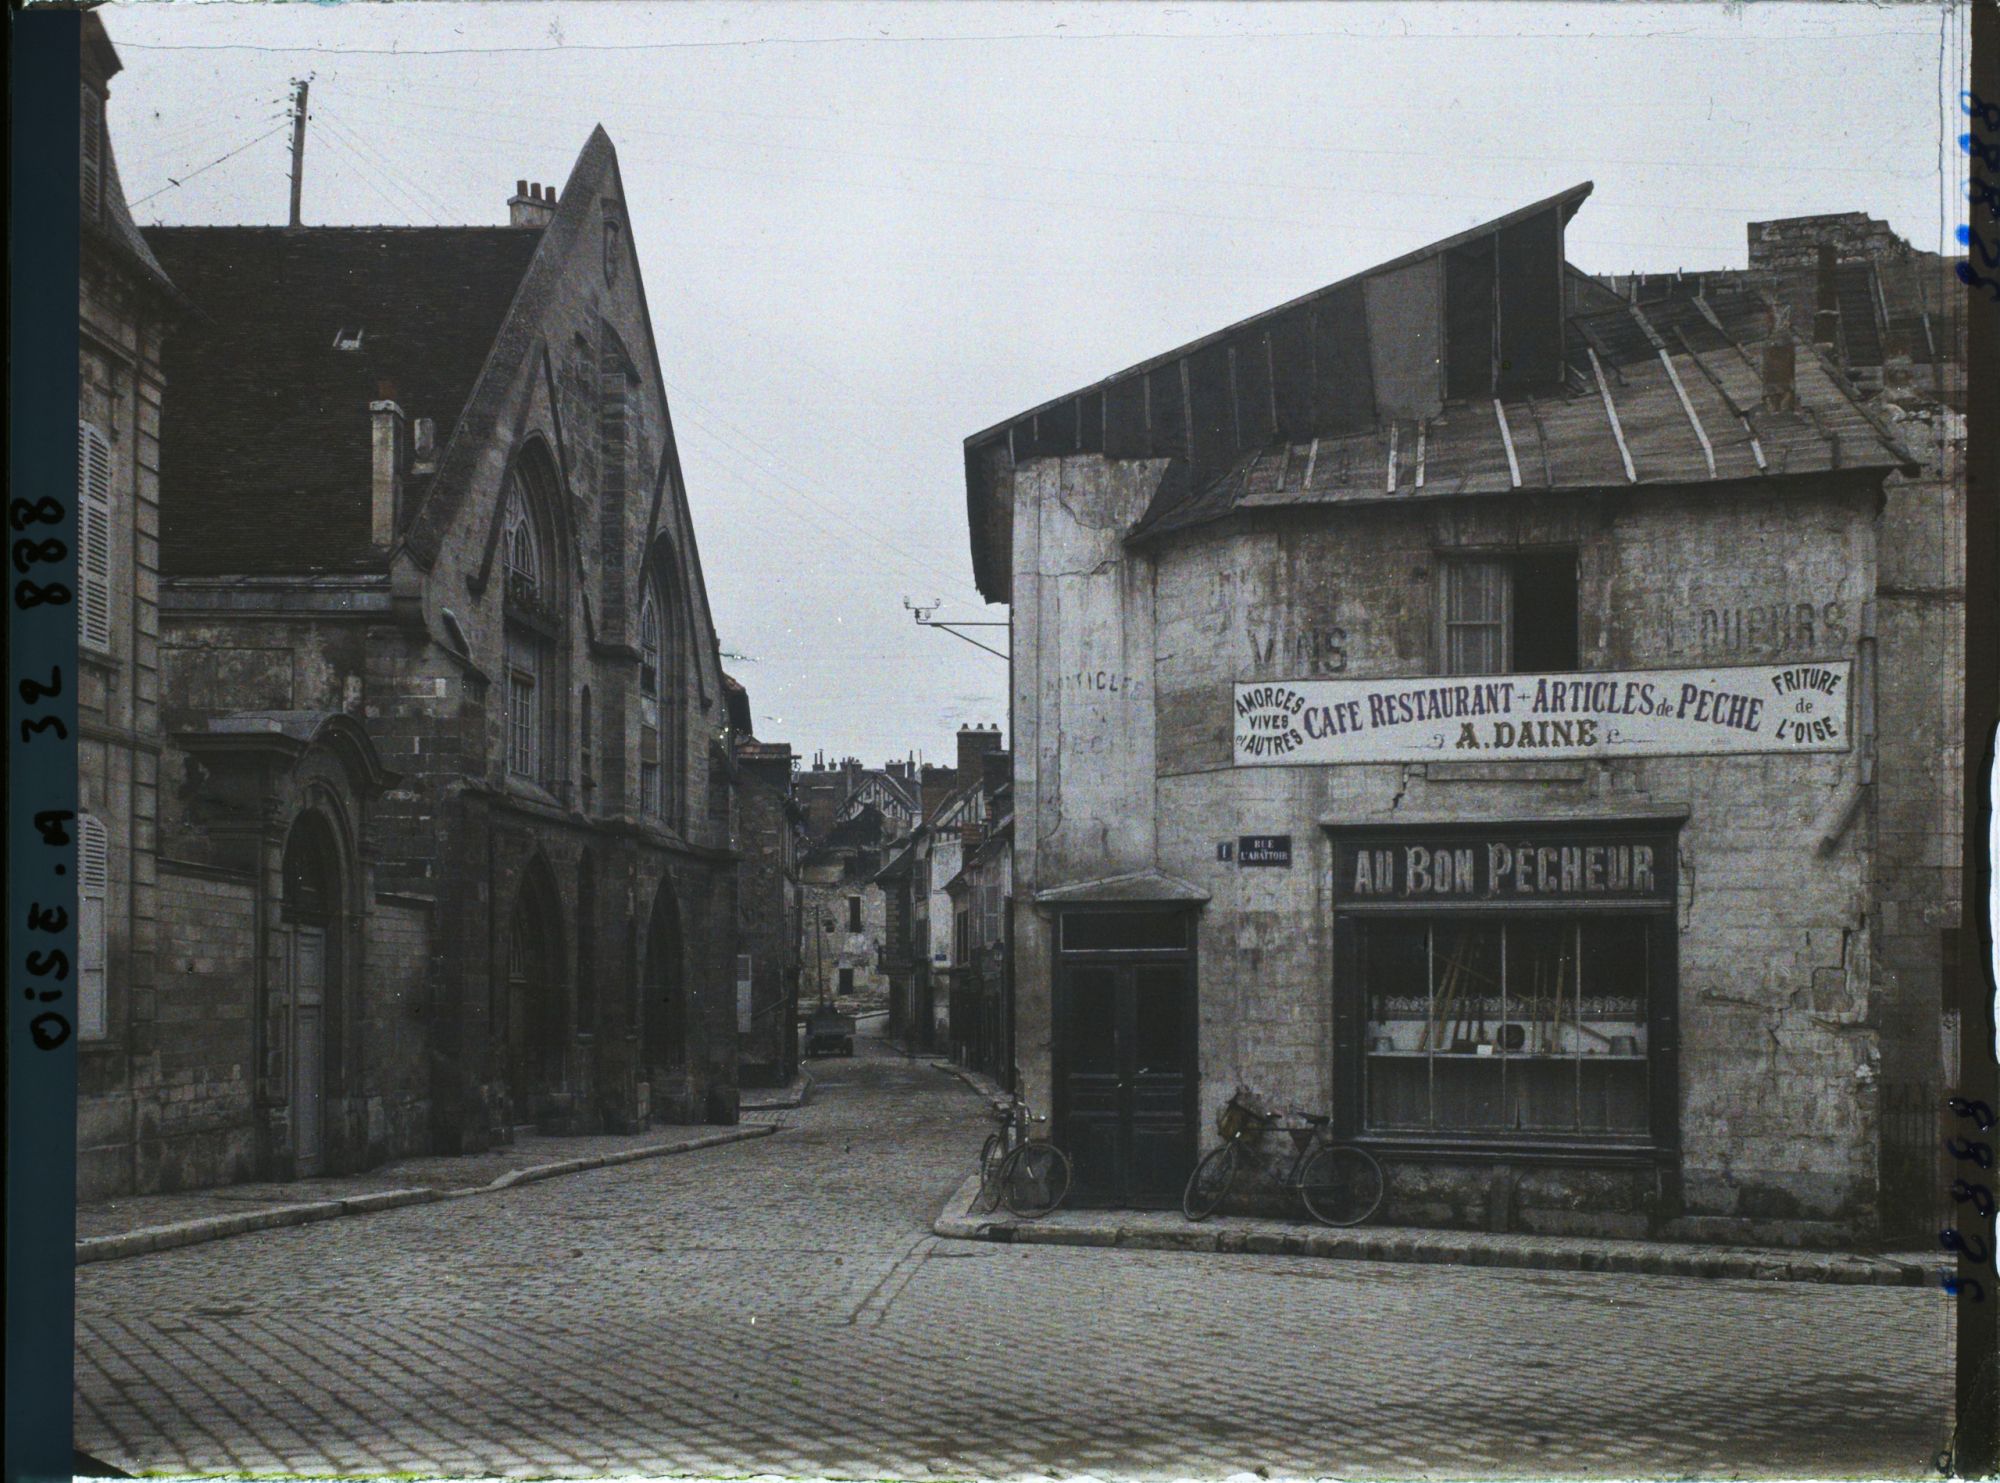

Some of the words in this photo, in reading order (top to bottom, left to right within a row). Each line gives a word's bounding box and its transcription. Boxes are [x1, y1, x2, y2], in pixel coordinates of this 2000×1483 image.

[10, 495, 73, 611] 888
[1771, 668, 1841, 696] FRITURE
[18, 665, 69, 744] 32
[1235, 687, 1305, 718] AMORCES
[1303, 701, 1363, 740] CAFE
[1368, 683, 1514, 729] RESTAURANT
[1532, 678, 1655, 716] ARTICLES
[1656, 697, 1674, 717] de
[1676, 683, 1764, 732] PECHE
[1795, 698, 1813, 714] de
[1249, 714, 1289, 730] VIVES
[1775, 716, 1838, 744] L'OISE
[1243, 728, 1304, 757] AUTRES
[1222, 844, 1227, 859] 1
[1240, 850, 1289, 861] L'ABATTOIR
[1254, 839, 1275, 849] RUE
[1353, 849, 1393, 895] AU
[1400, 846, 1474, 897] BON
[1482, 840, 1655, 900] PÊCHEUR
